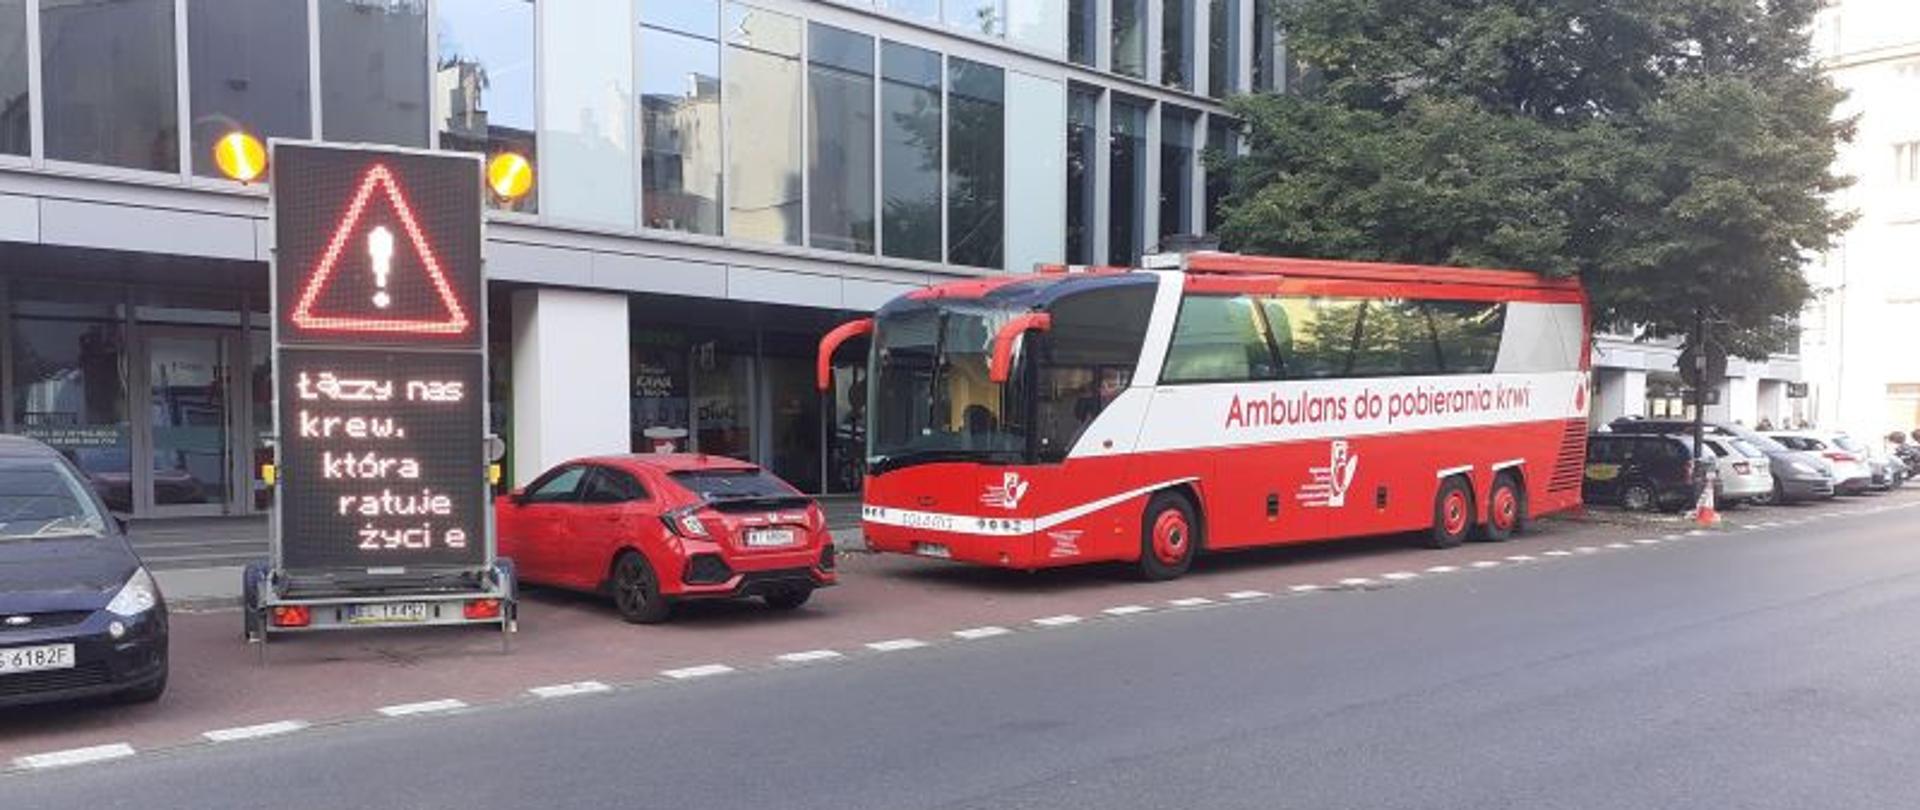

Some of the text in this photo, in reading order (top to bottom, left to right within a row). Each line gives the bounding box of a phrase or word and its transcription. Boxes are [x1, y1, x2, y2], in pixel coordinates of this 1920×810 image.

[406, 380, 464, 401] nas
[1225, 380, 1531, 429] Ambulans do pobierania krwi
[323, 452, 419, 478] która
[340, 489, 451, 515] ratuje
[12, 647, 68, 668] 6182F
